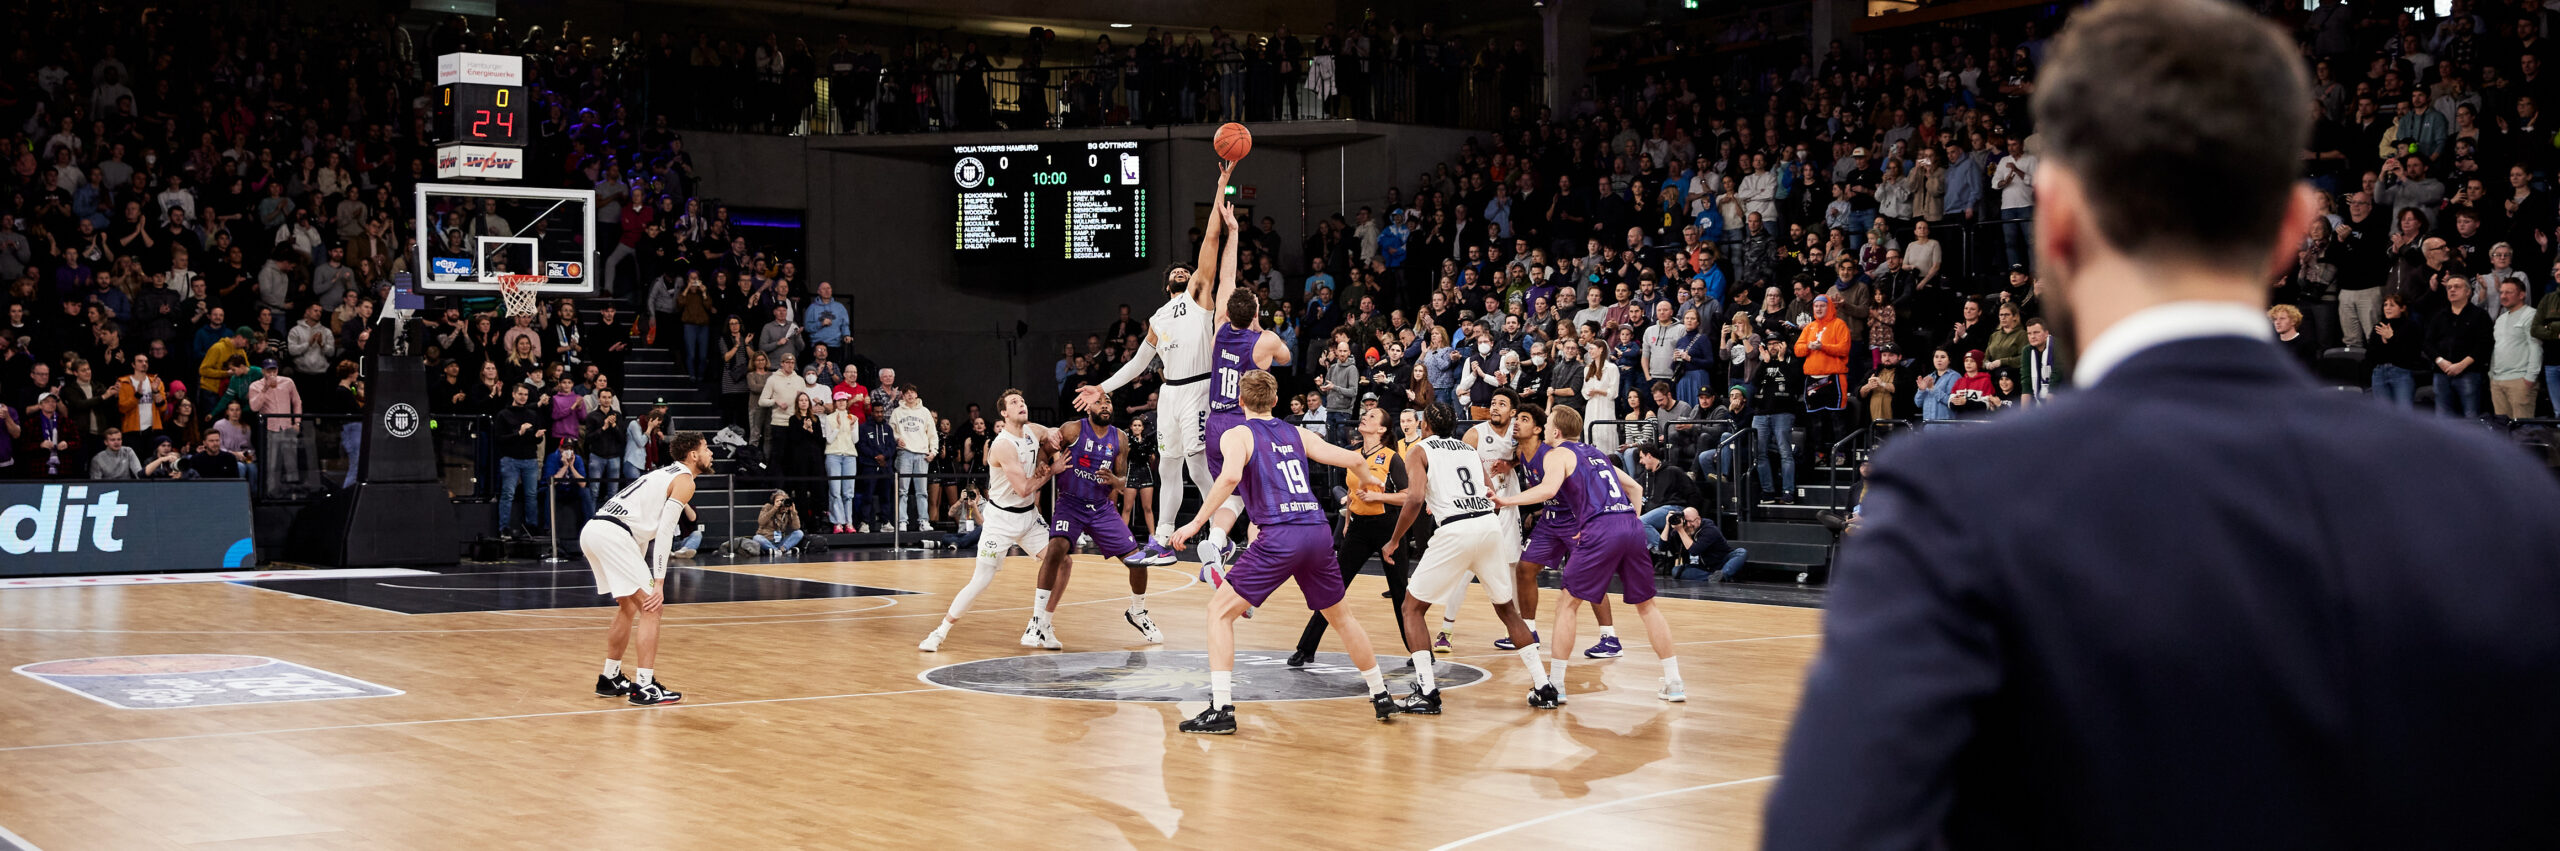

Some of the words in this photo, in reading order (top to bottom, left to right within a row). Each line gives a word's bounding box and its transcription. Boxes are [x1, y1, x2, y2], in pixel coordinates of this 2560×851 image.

[467, 69, 515, 78] Energiewerke
[497, 89, 509, 107] 0
[473, 110, 514, 137] 24
[1006, 144, 1039, 152] HAMBURG
[1099, 141, 1137, 149] GÖTTINGEN
[1000, 157, 1008, 169] 0
[1046, 155, 1051, 165] 1
[1089, 154, 1097, 167] 0
[988, 177, 994, 186] 0
[1033, 172, 1067, 185] 10:00
[1104, 174, 1111, 183] 0
[1172, 302, 1187, 318] 23
[1218, 367, 1239, 399] 18
[1276, 459, 1309, 494] 19
[1456, 467, 1475, 496] 8
[1599, 470, 1621, 498] 3
[0, 485, 128, 555] dit
[1055, 520, 1069, 532] 20
